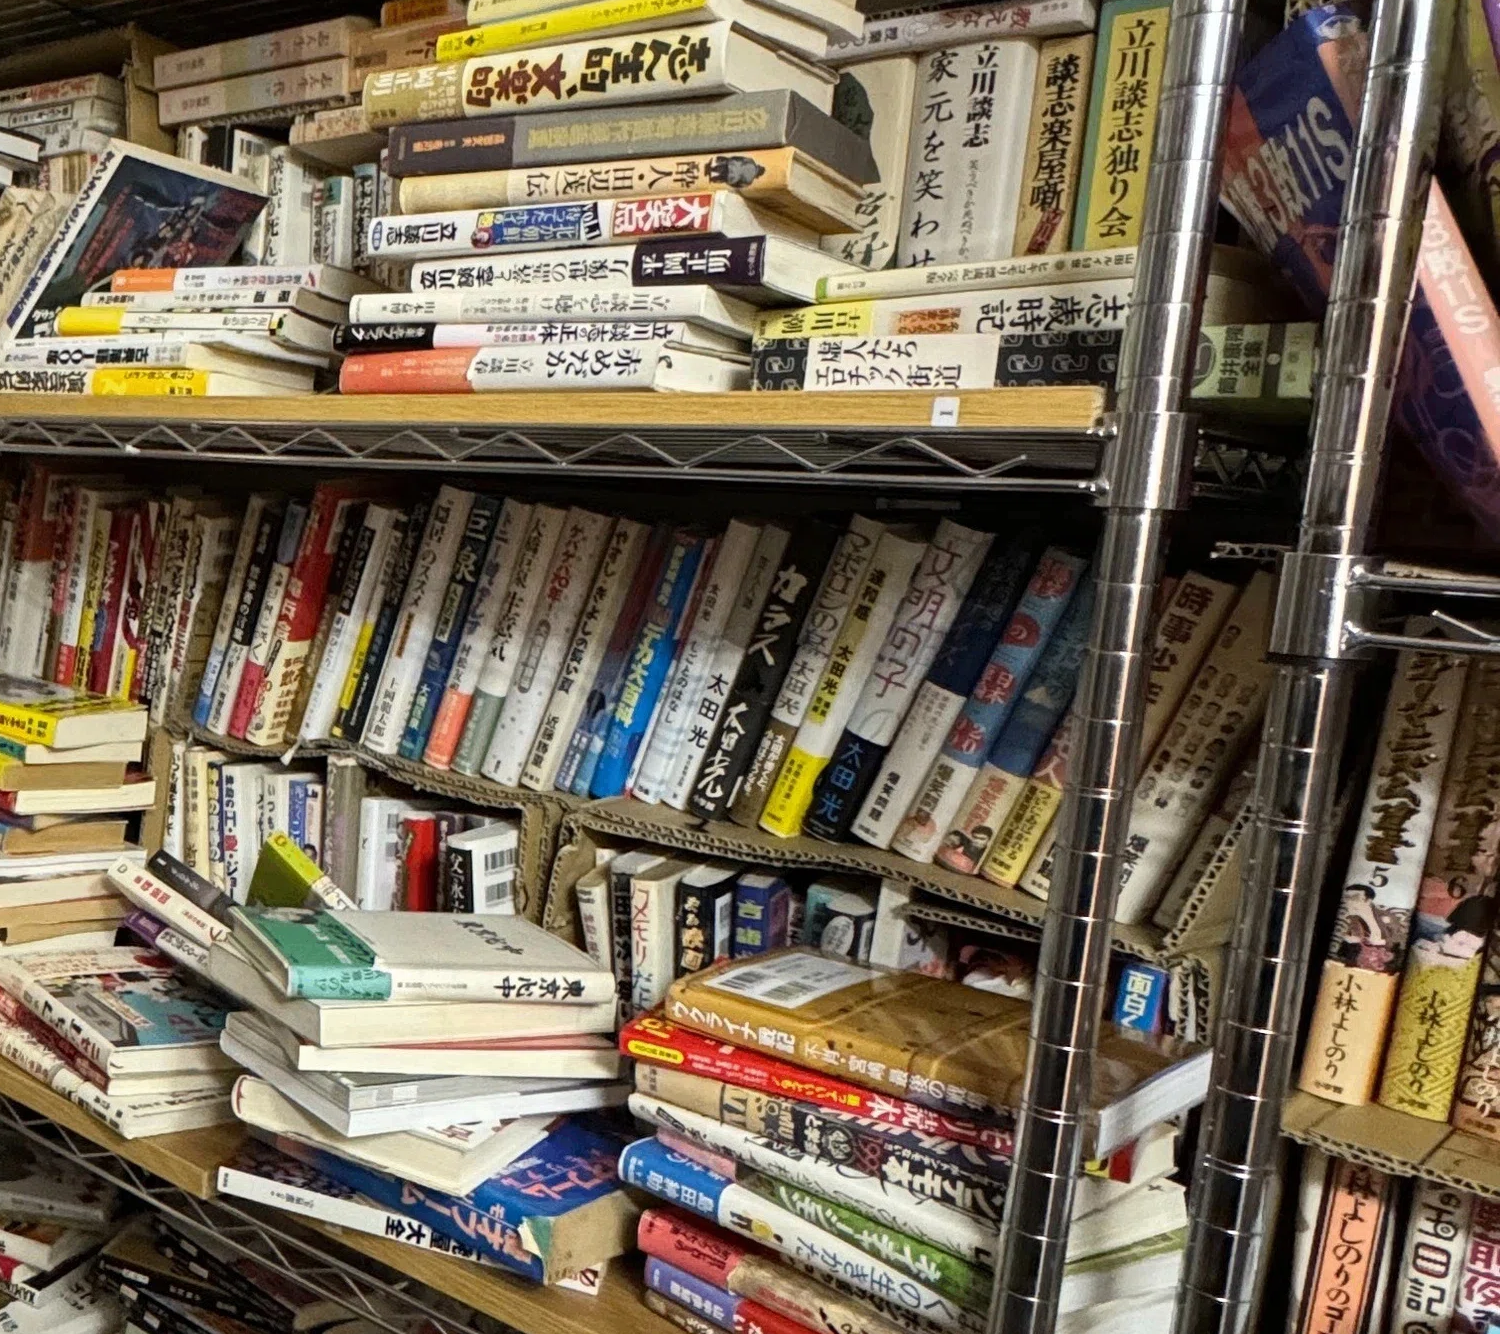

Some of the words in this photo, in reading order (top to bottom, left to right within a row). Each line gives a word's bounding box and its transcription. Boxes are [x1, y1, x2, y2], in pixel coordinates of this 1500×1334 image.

[463, 35, 715, 111] 志ん生的、文楽的
[962, 44, 1001, 148] 立川談志
[1029, 55, 1081, 213] 談志楽屋噺
[1095, 18, 1157, 240] 立川談志独り会
[525, 160, 696, 200] 酔人・田辺茂一伝
[608, 158, 717, 225] 大笑点
[386, 170, 457, 250] 立川談志
[418, 250, 631, 292] 立川談志と落語の想像力
[636, 245, 734, 279] 平岡正明
[536, 321, 675, 344] 立川談志の正体
[976, 293, 1138, 335] 志歳時記
[545, 345, 644, 380] 赤めだか
[814, 362, 963, 389] エロチック街道
[816, 339, 919, 364] 虚人たち
[453, 507, 491, 584] 巨泉
[748, 565, 806, 666] カラス
[851, 567, 884, 625] 違和感
[873, 534, 963, 703] 文明の子
[775, 658, 809, 719] 太田光
[820, 642, 853, 698] 太田光
[688, 670, 727, 752] 太田光
[704, 700, 747, 800] 太田光
[822, 739, 864, 826] 太田光
[1369, 867, 1389, 889] 5
[1448, 876, 1467, 900] 6
[493, 972, 587, 1000] 東京心中
[671, 998, 798, 1053] ウクライナ戦記
[1323, 973, 1363, 1081] 小林よしのり
[1407, 990, 1447, 1094] 小林よしのり
[801, 1036, 888, 1078] 不肖・宮嶋
